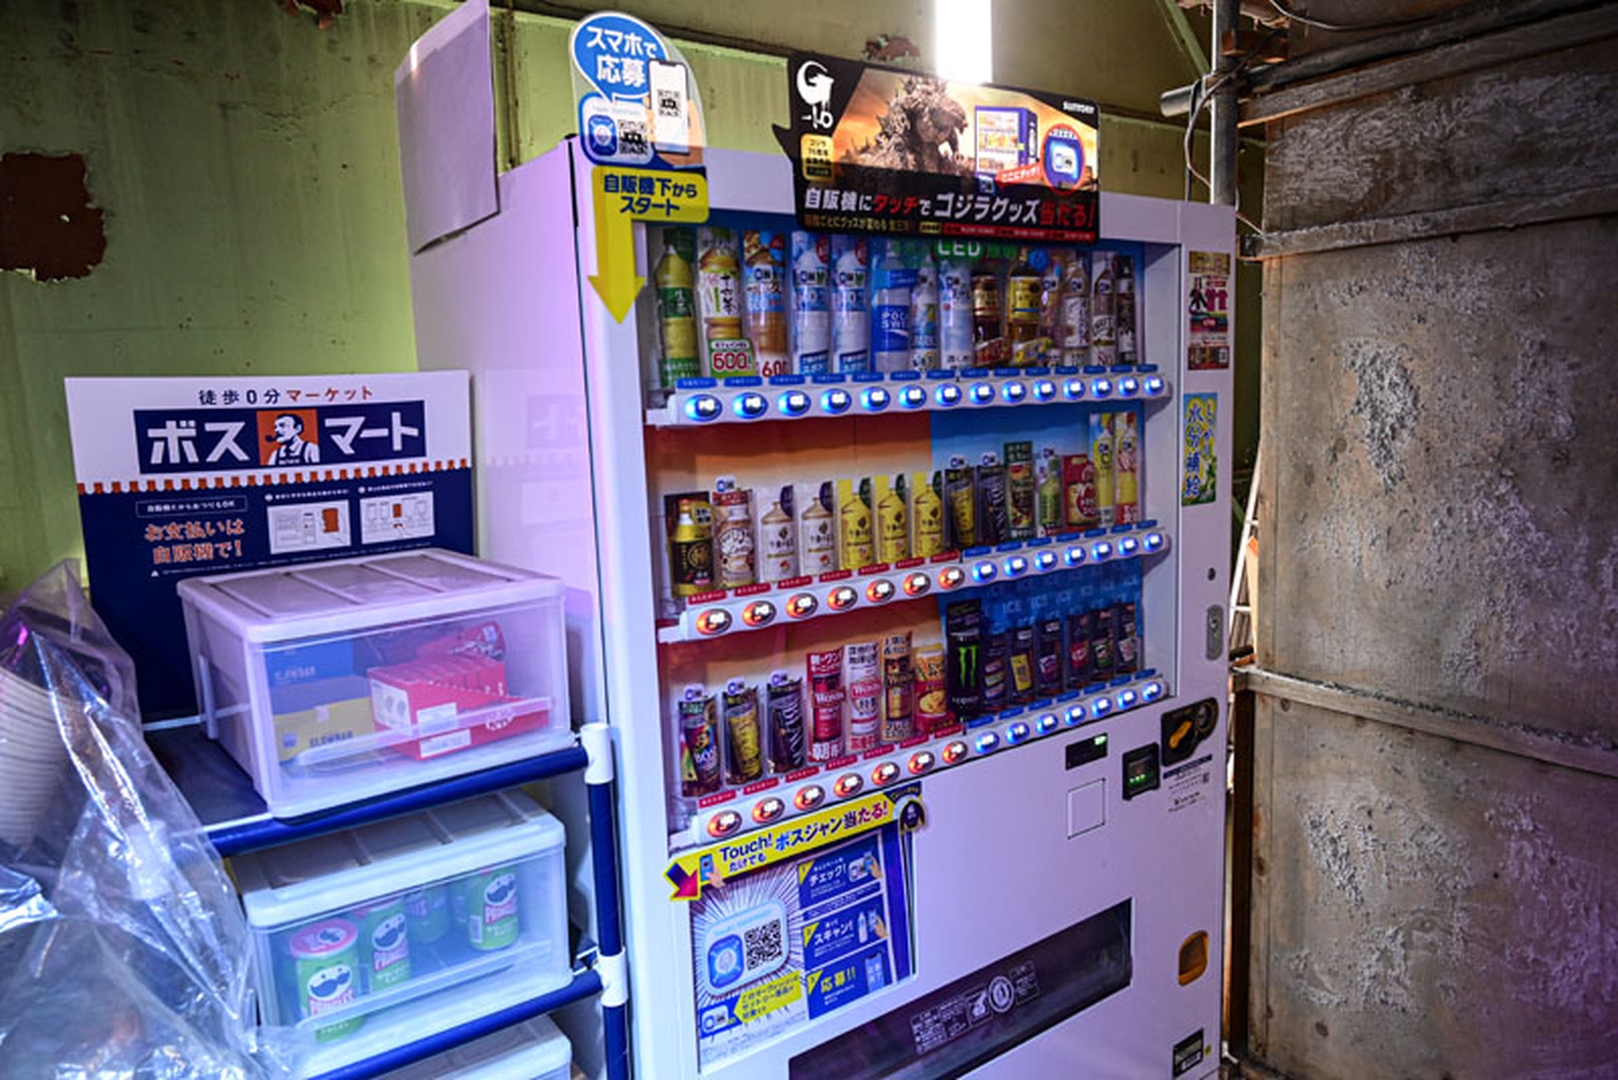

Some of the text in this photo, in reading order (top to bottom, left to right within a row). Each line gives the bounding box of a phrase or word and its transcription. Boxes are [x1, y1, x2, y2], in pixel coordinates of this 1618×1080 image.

[587, 26, 657, 58] スマホで
[597, 55, 645, 87] 応募
[604, 174, 698, 198] 自販機下から
[620, 196, 680, 217] スタート
[938, 240, 981, 256] LED
[198, 385, 373, 405] 徒歩0分マーケット
[147, 411, 419, 464] ボス マート
[145, 518, 245, 541] お支払いは
[153, 540, 242, 565] 自販機で!
[719, 800, 889, 862] Touch! ボスジャン当たる!
[814, 920, 854, 945] スキャン!
